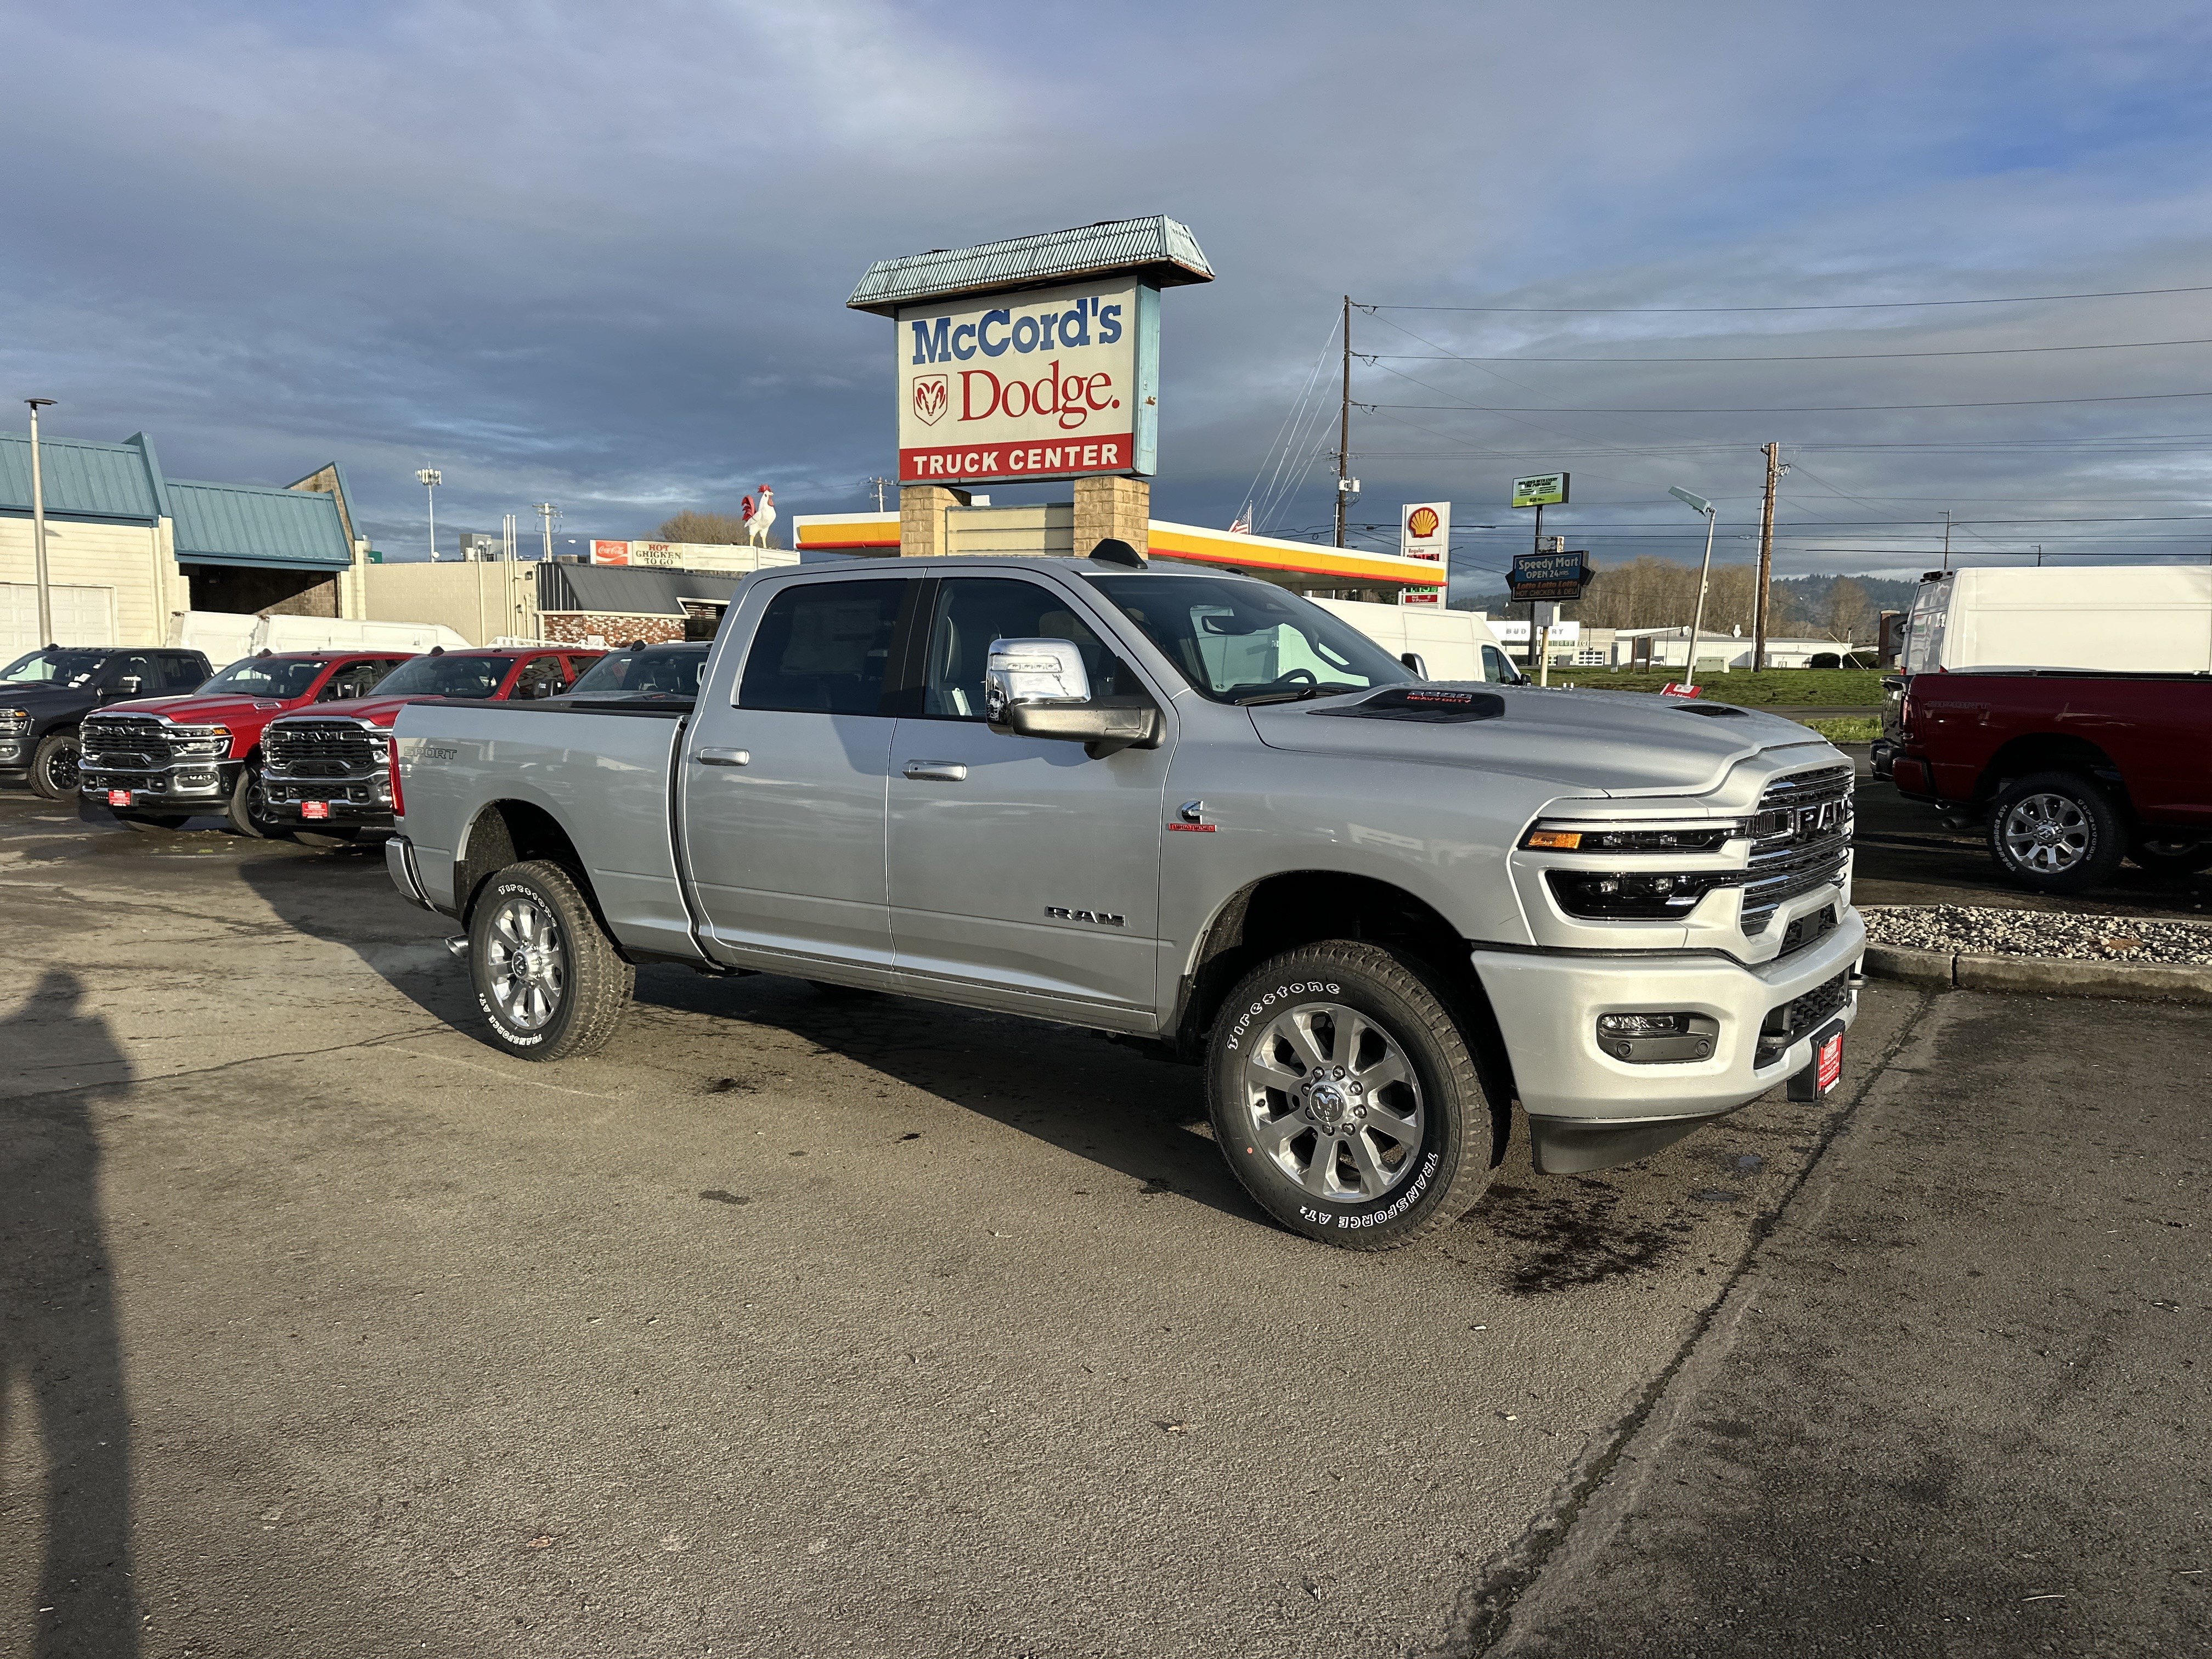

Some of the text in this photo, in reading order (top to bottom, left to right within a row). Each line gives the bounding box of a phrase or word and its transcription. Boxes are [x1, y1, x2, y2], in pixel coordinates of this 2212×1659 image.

[912, 297, 1122, 365] McCord's
[913, 443, 1119, 476] TRUCK CENTER
[635, 550, 682, 560] CHICKEN
[1519, 556, 1579, 572] Speedy Mart
[1526, 571, 1548, 579] OPEN
[1549, 570, 1559, 578] 24
[1558, 580, 1578, 588] Lotto
[403, 746, 458, 760] SPORT
[1796, 798, 1848, 834] RAM
[498, 884, 557, 928] Firestone
[1044, 905, 1126, 927] RAM
[488, 1015, 543, 1046] TRANSFORCE
[1227, 981, 1340, 1050] Firestone
[1338, 1152, 1438, 1228] TRANSFORCE
